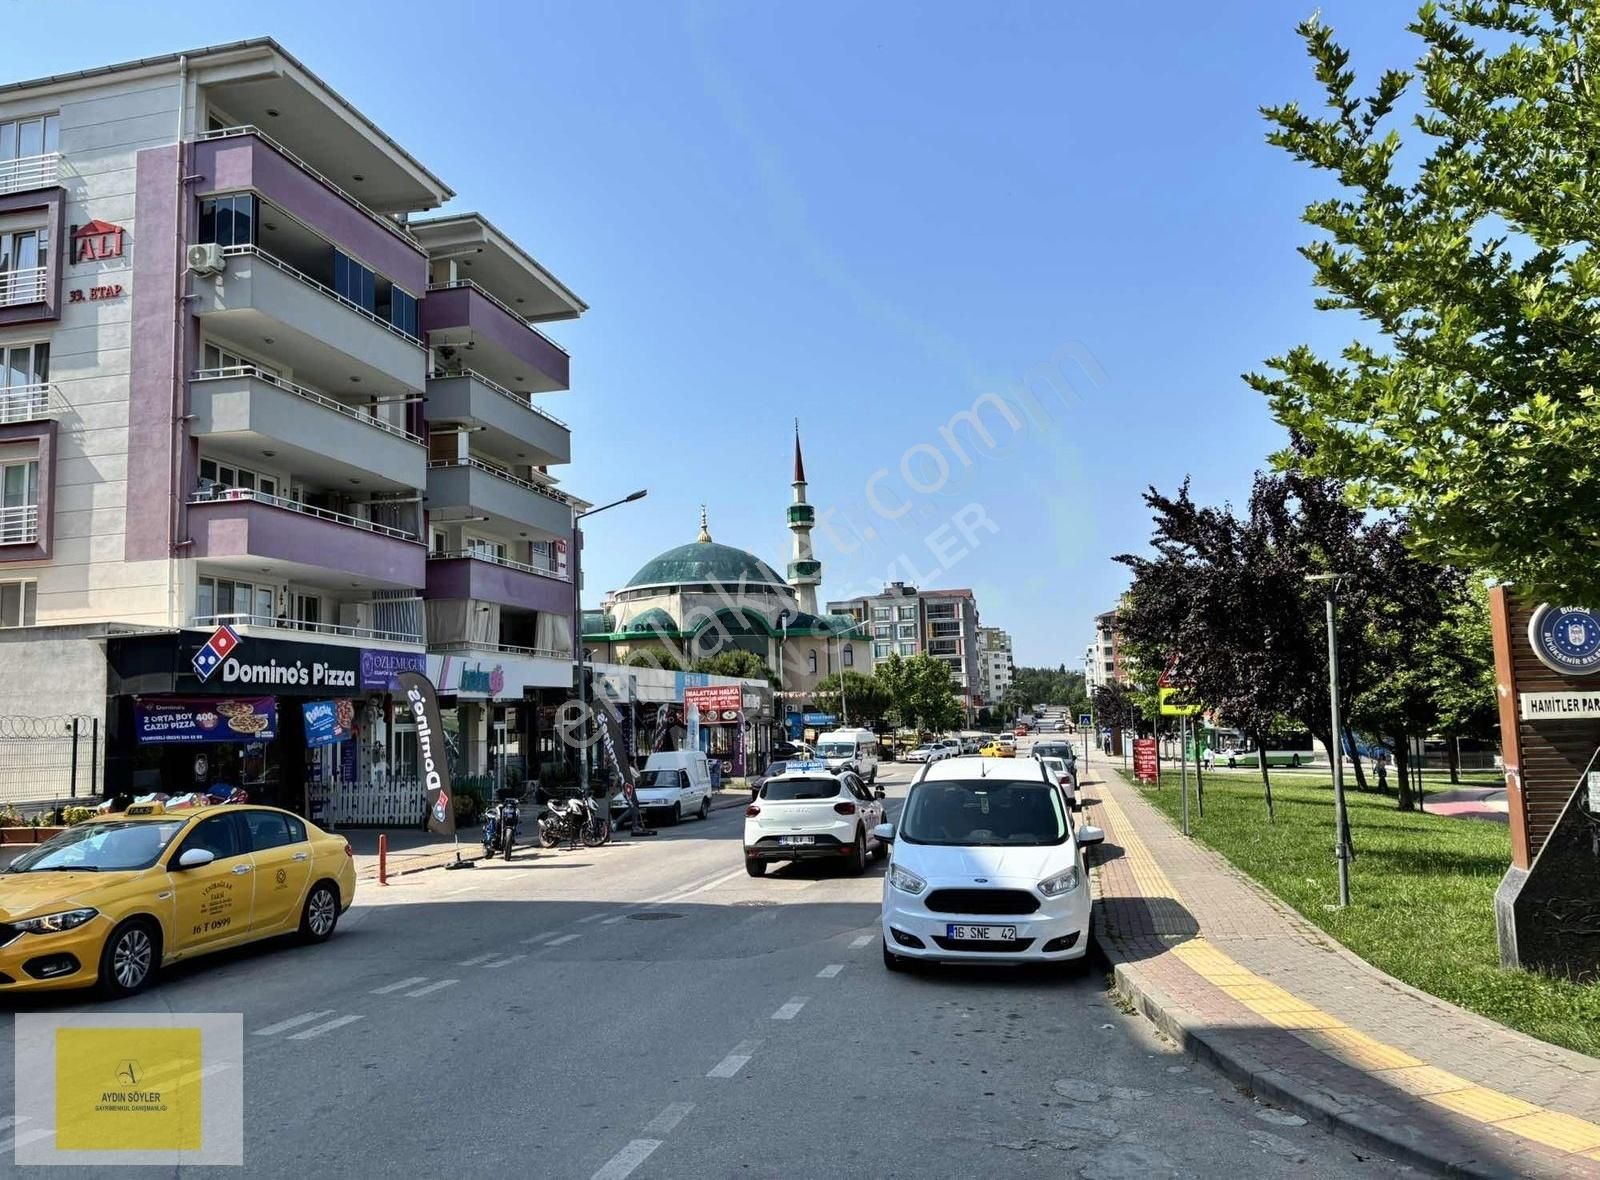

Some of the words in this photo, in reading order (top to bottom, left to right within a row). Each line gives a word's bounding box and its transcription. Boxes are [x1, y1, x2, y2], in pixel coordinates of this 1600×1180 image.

[89, 285, 122, 301] ETAP
[1544, 631, 1581, 665] BÜYÜKŞEHİR
[223, 657, 309, 685] Domino's
[312, 662, 355, 686] Pizza
[1531, 696, 1579, 713] HAMİTLER
[151, 714, 174, 722] ORTA
[175, 713, 193, 721] BOY
[196, 712, 213, 722] 400
[407, 685, 441, 790] Domino's
[192, 925, 201, 935] 16
[203, 922, 210, 932] T
[211, 917, 231, 930] 0899
[955, 927, 965, 938] 16
[970, 927, 990, 939] SNE
[1001, 928, 1015, 940] 42
